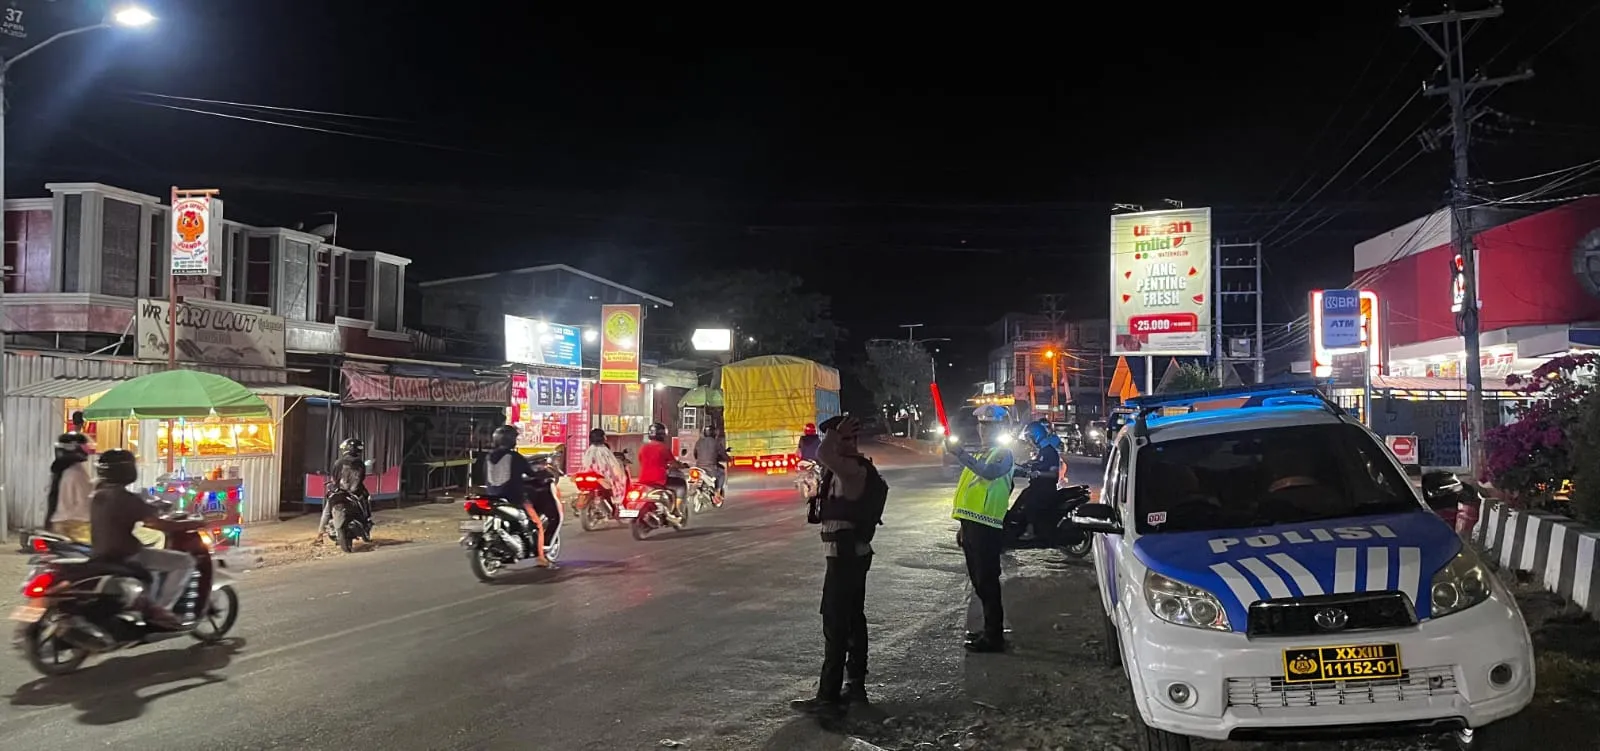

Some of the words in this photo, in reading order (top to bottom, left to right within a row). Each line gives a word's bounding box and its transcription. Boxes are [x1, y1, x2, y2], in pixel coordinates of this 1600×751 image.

[5, 8, 24, 23] 37
[1135, 237, 1171, 252] mild
[1145, 262, 1177, 278] YANG
[1135, 276, 1187, 293] PENTING
[1143, 290, 1181, 307] FRESH
[1338, 297, 1358, 308] BRI
[142, 303, 161, 320] WR
[212, 312, 258, 333] LAUT
[1330, 319, 1355, 328] ATM
[393, 376, 430, 401] AYAM
[444, 380, 477, 402] SOTO
[1208, 525, 1397, 554] POLISI
[1335, 646, 1384, 660] XXXIII
[1324, 660, 1395, 676] 11152-01
